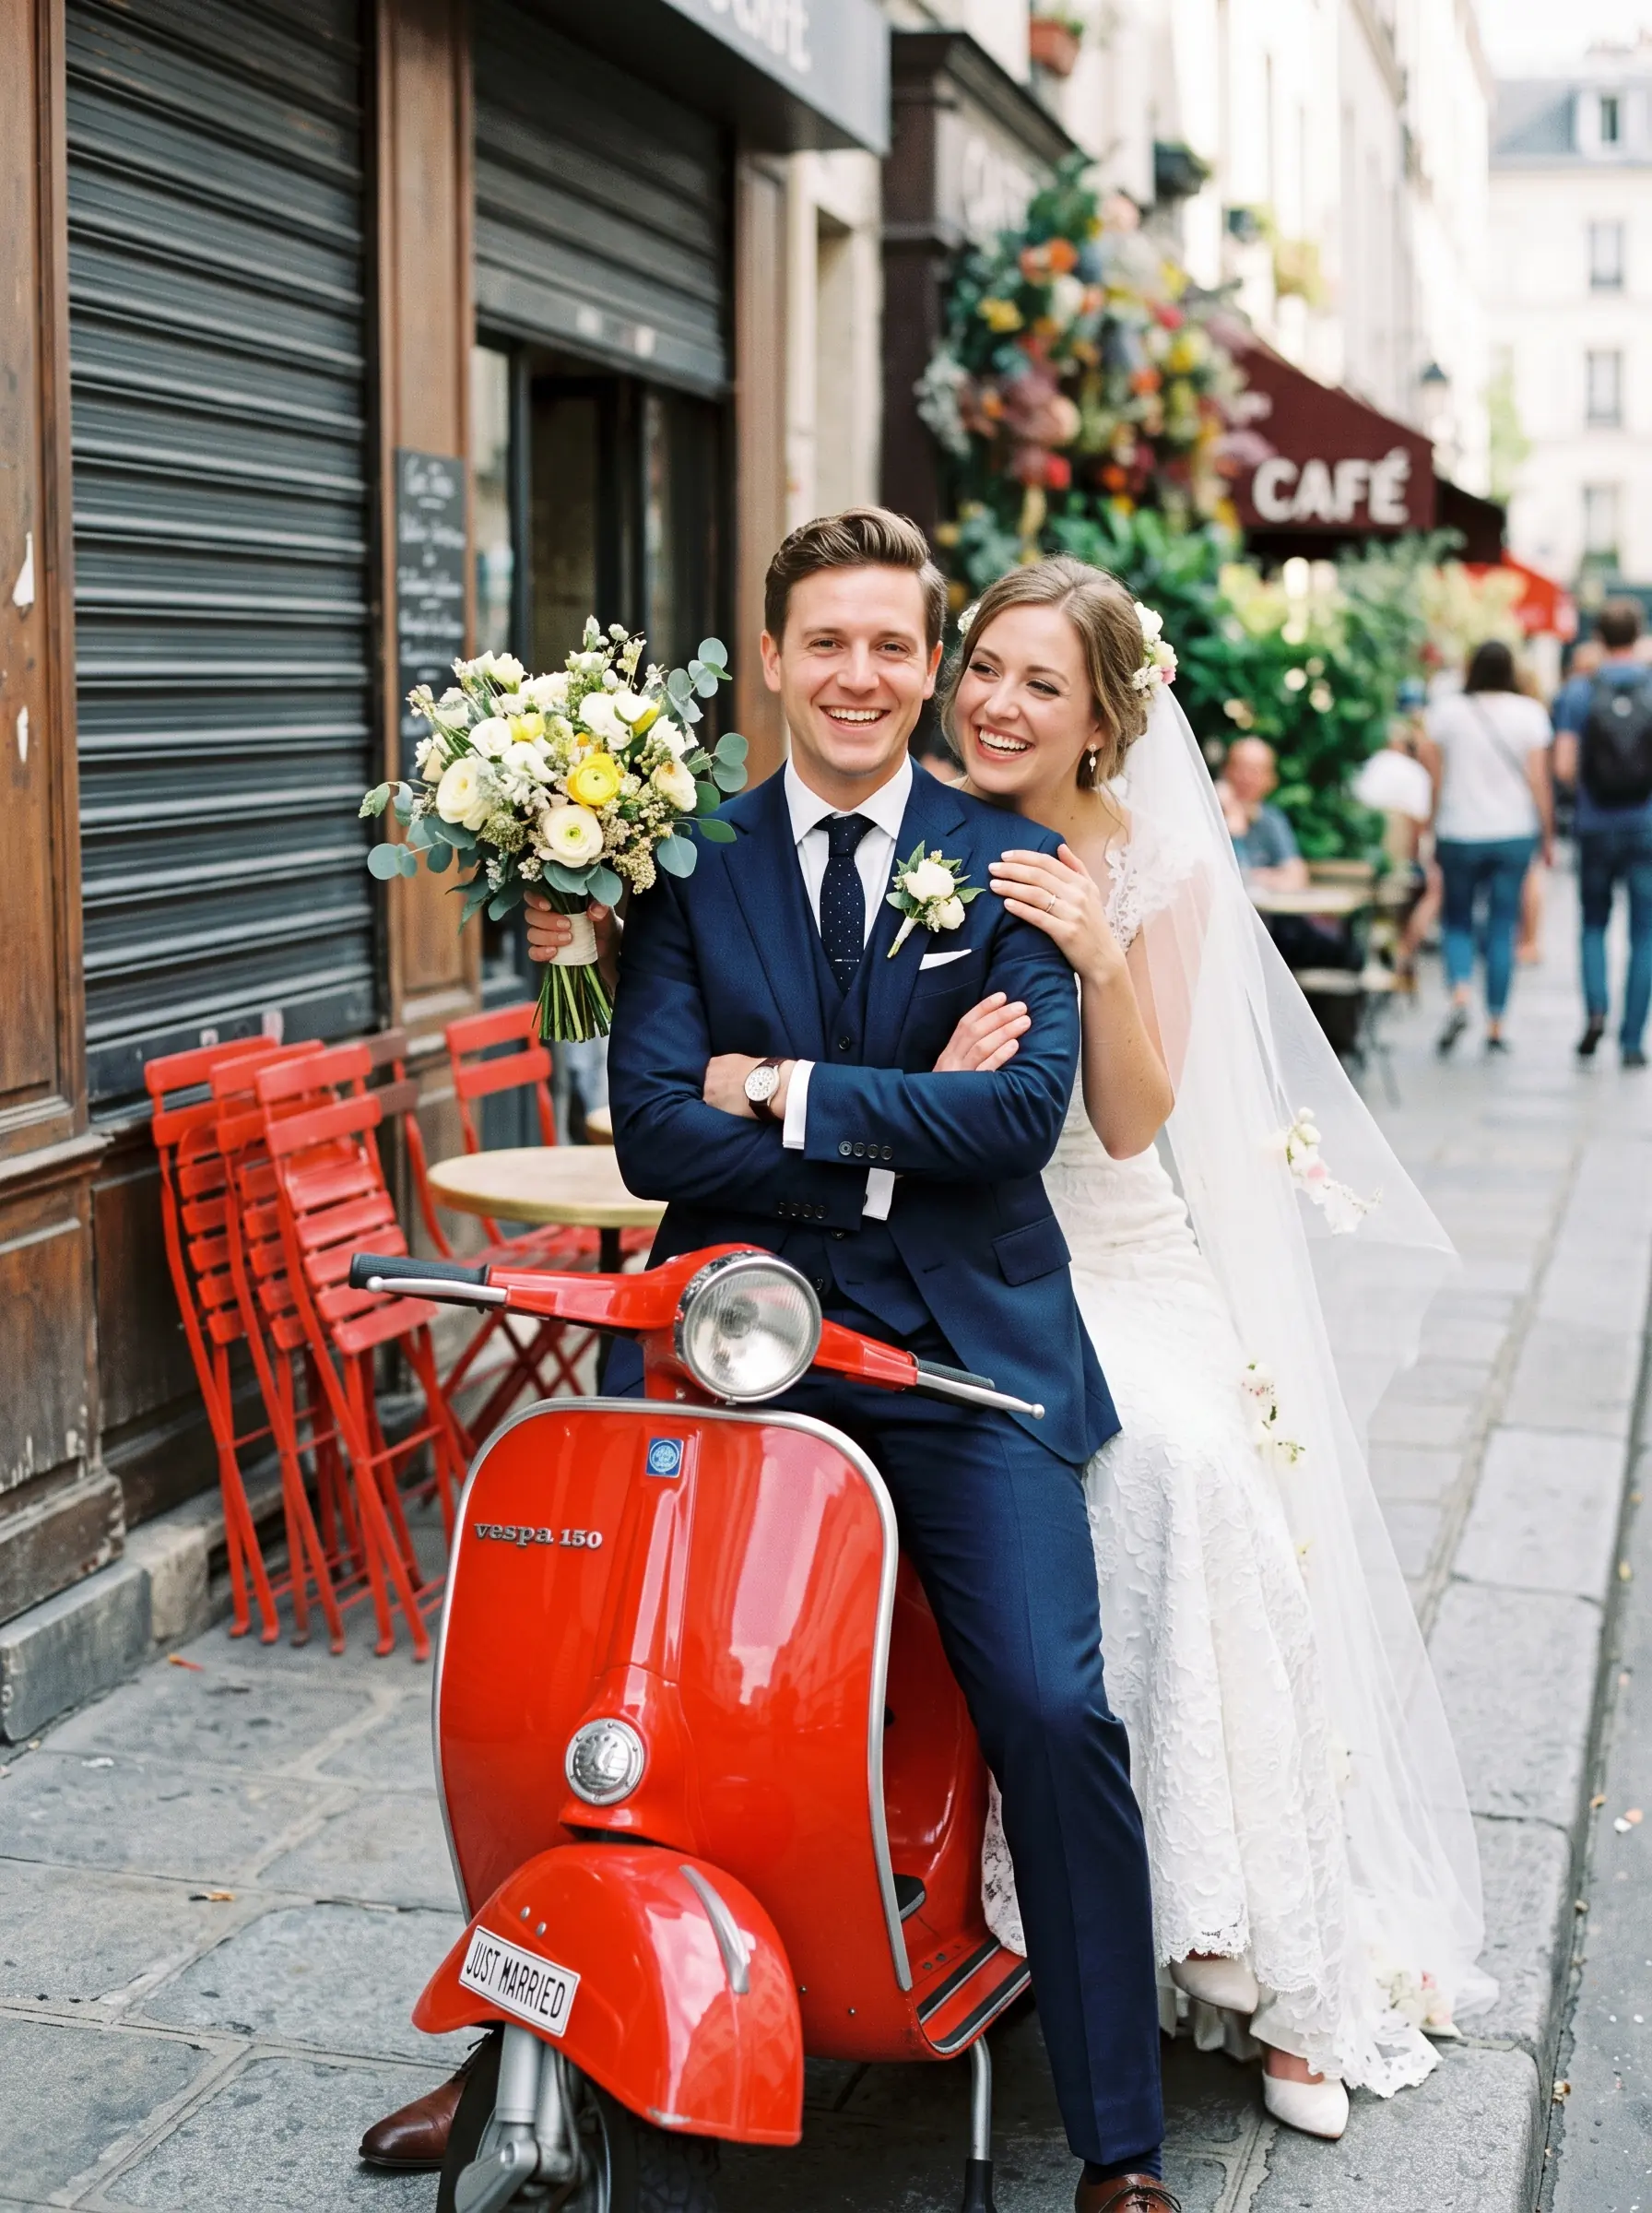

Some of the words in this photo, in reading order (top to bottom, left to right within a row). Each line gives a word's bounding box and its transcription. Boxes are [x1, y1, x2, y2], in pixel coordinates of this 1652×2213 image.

[1252, 446, 1410, 525] CAFÉ
[474, 1522, 554, 1546] vespa
[559, 1528, 603, 1549] 150
[466, 1941, 501, 1985] JUST
[498, 1956, 565, 2018] MARRIED
